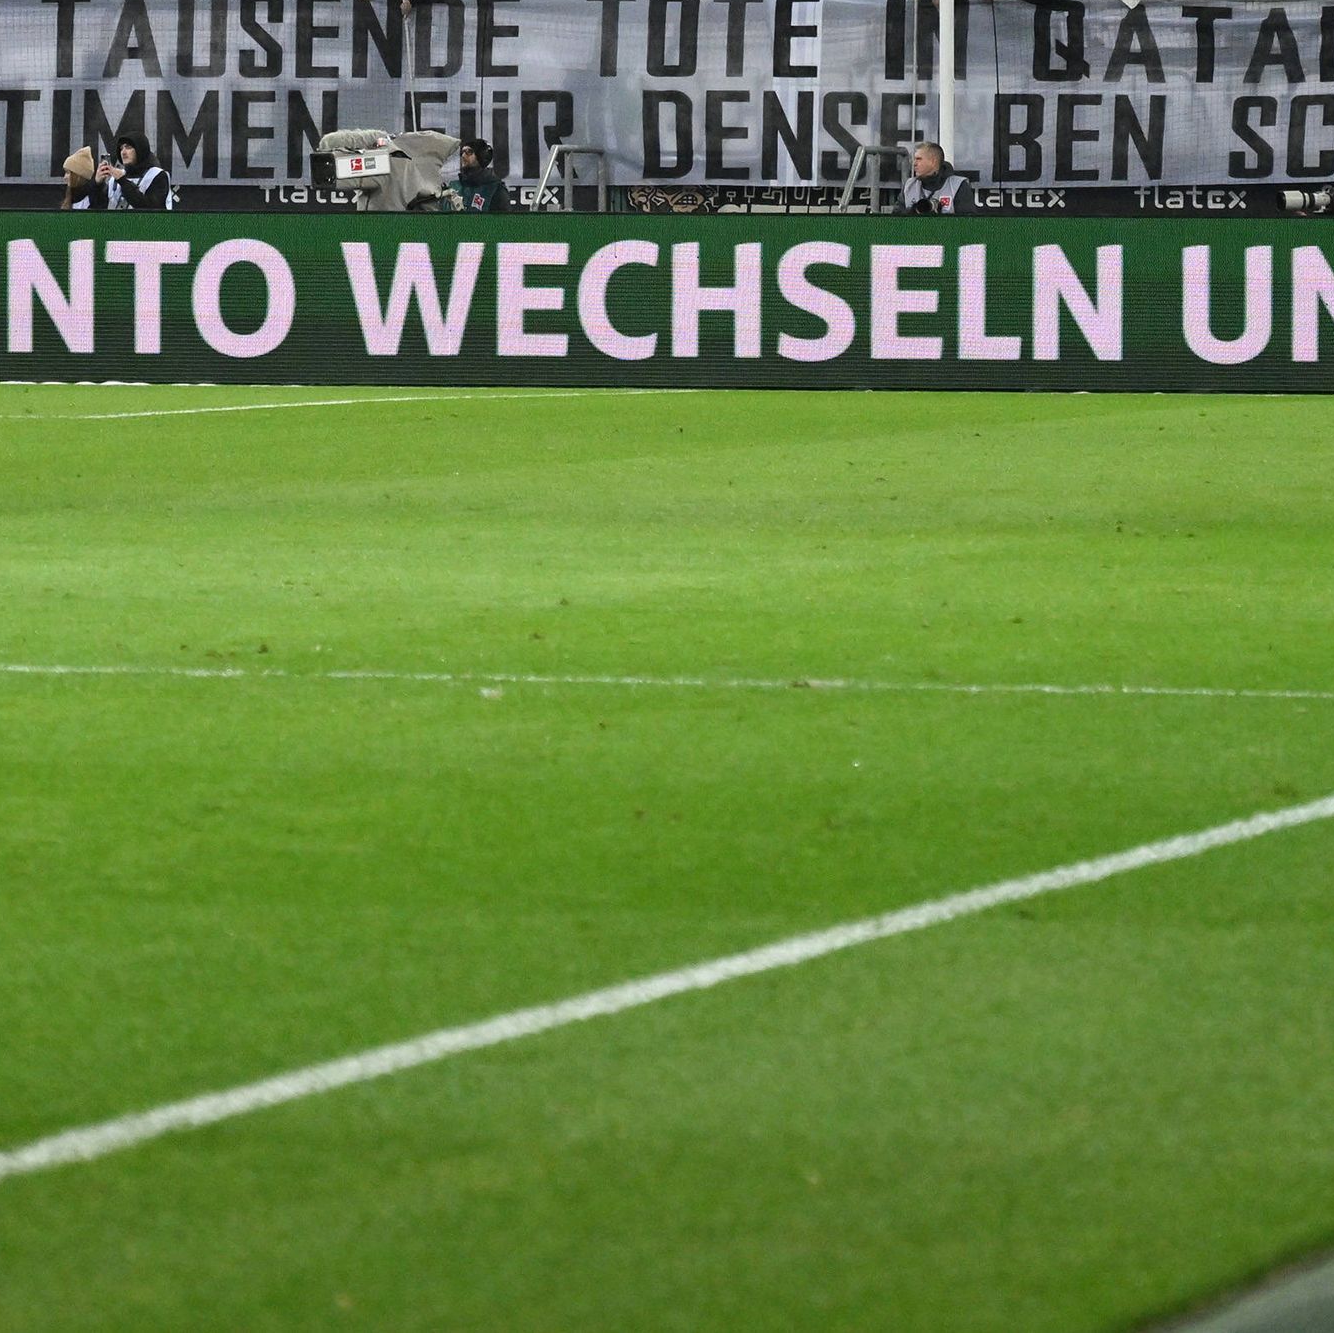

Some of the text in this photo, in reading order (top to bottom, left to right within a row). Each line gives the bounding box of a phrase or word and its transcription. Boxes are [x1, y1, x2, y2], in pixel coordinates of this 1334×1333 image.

[404, 91, 579, 180] FÜR
[642, 90, 1166, 183] DENSEBEN
[973, 187, 1066, 208] latex
[340, 241, 1124, 362] WECHSELN
